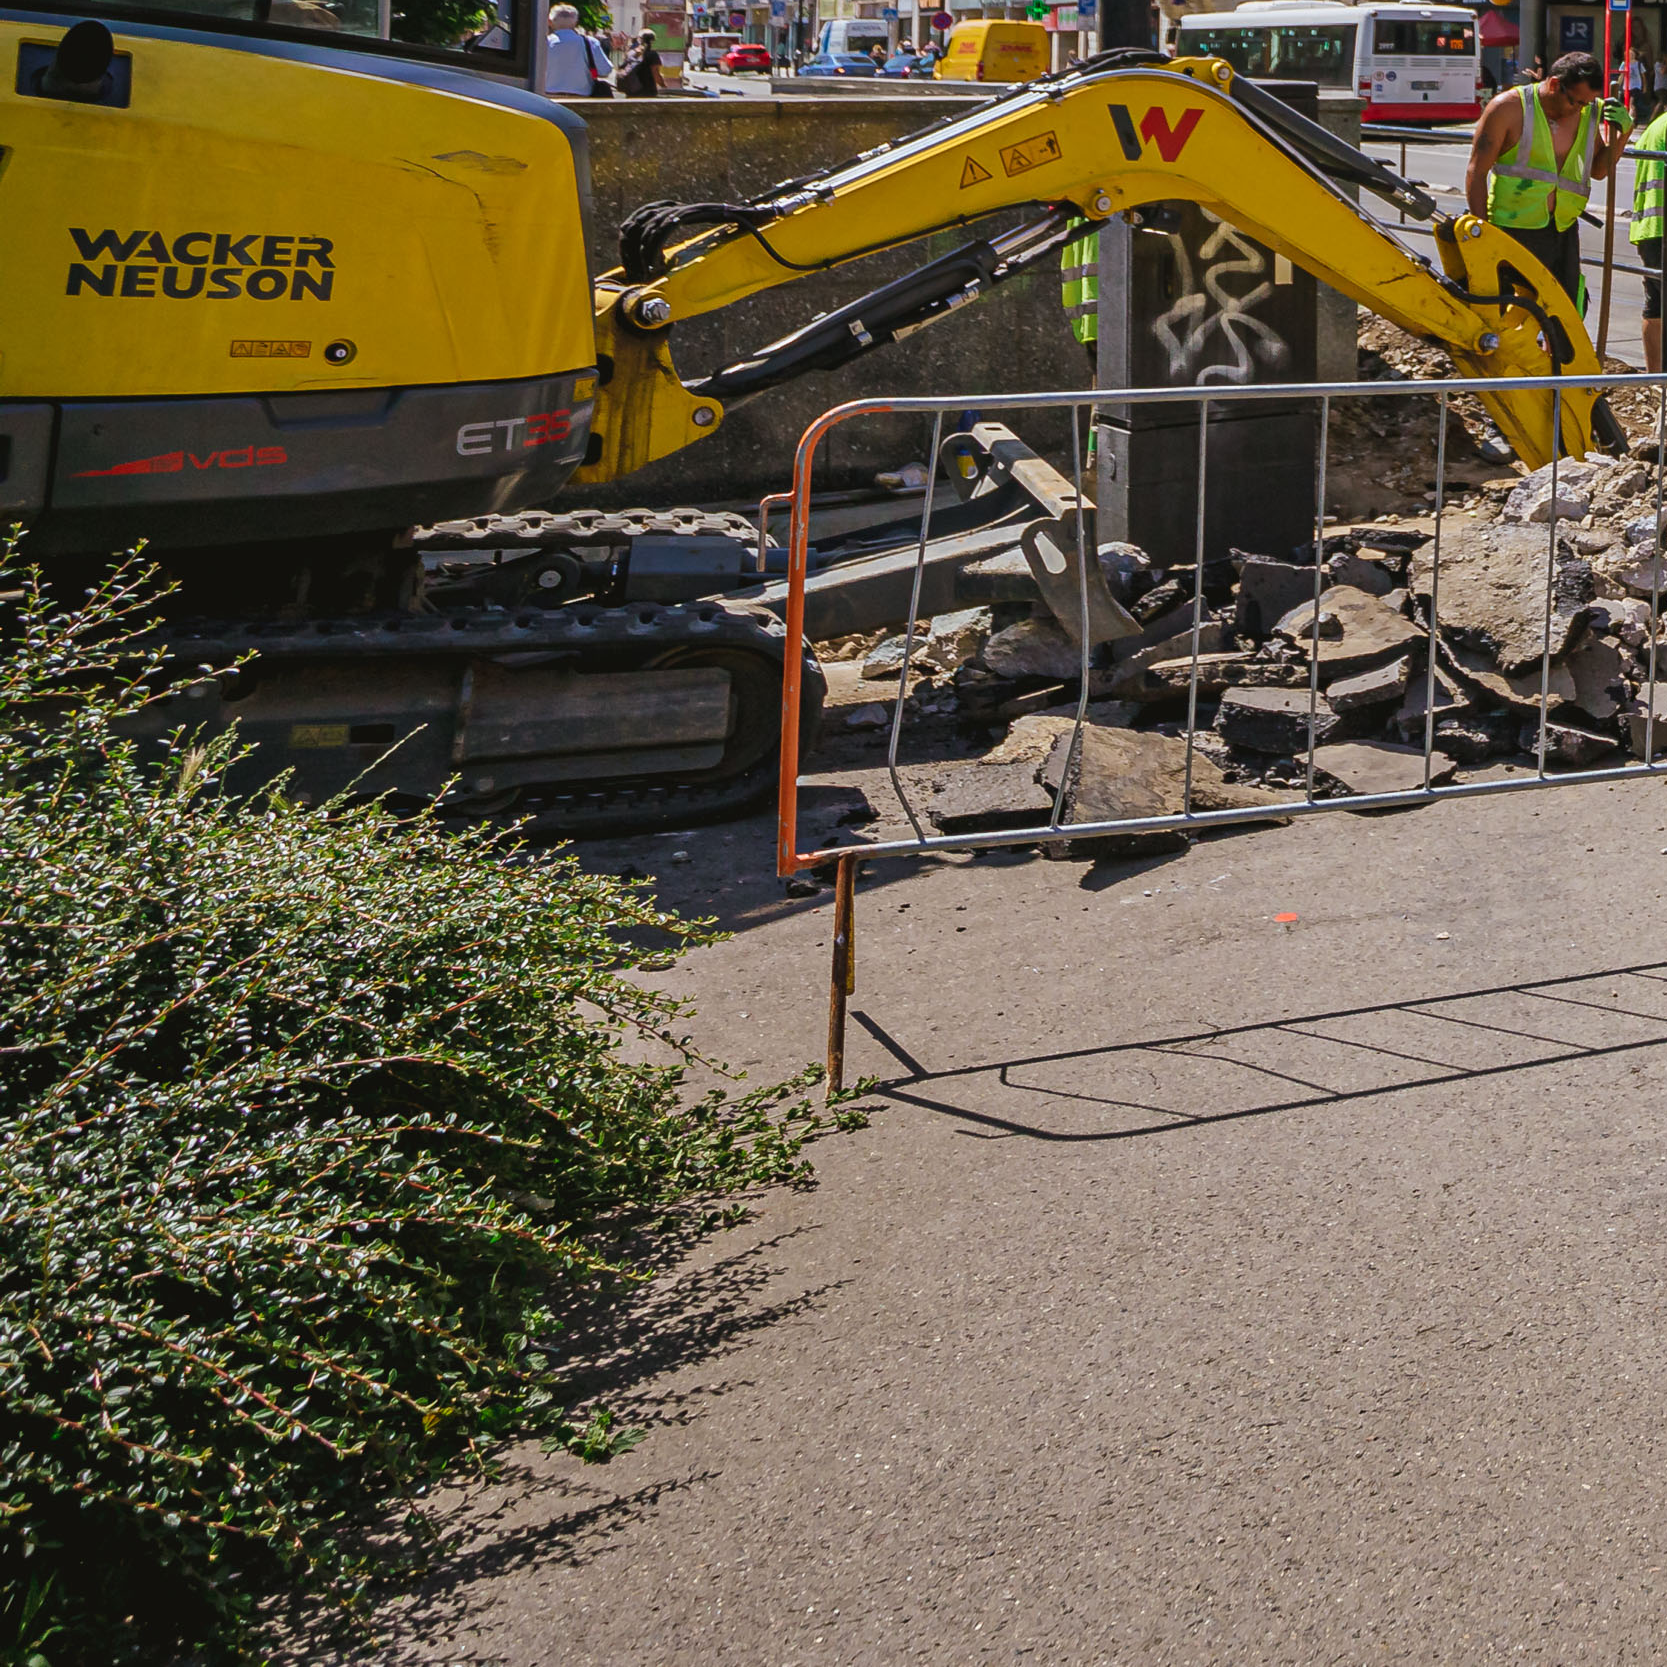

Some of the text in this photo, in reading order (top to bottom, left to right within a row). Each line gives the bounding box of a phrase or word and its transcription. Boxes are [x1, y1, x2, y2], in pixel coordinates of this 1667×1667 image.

[67, 227, 337, 269] WACKER
[66, 263, 336, 302] NEUSON
[456, 409, 572, 457] ET35
